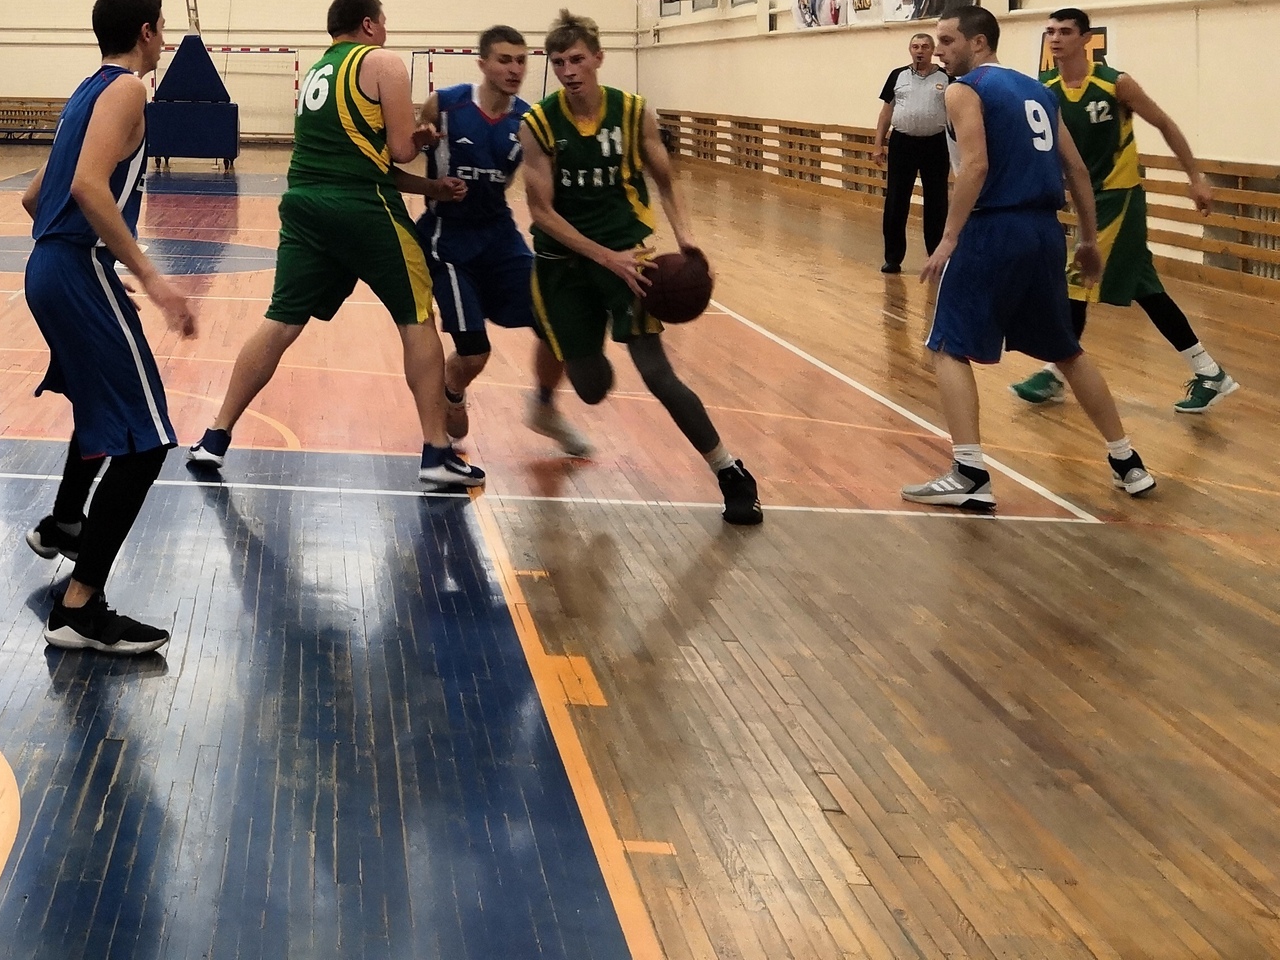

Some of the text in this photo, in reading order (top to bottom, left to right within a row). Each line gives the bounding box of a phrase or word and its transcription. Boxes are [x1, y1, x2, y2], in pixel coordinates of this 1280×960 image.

[297, 63, 334, 117] 16
[1024, 99, 1053, 152] 9
[1084, 100, 1114, 124] 12
[596, 126, 623, 157] 11
